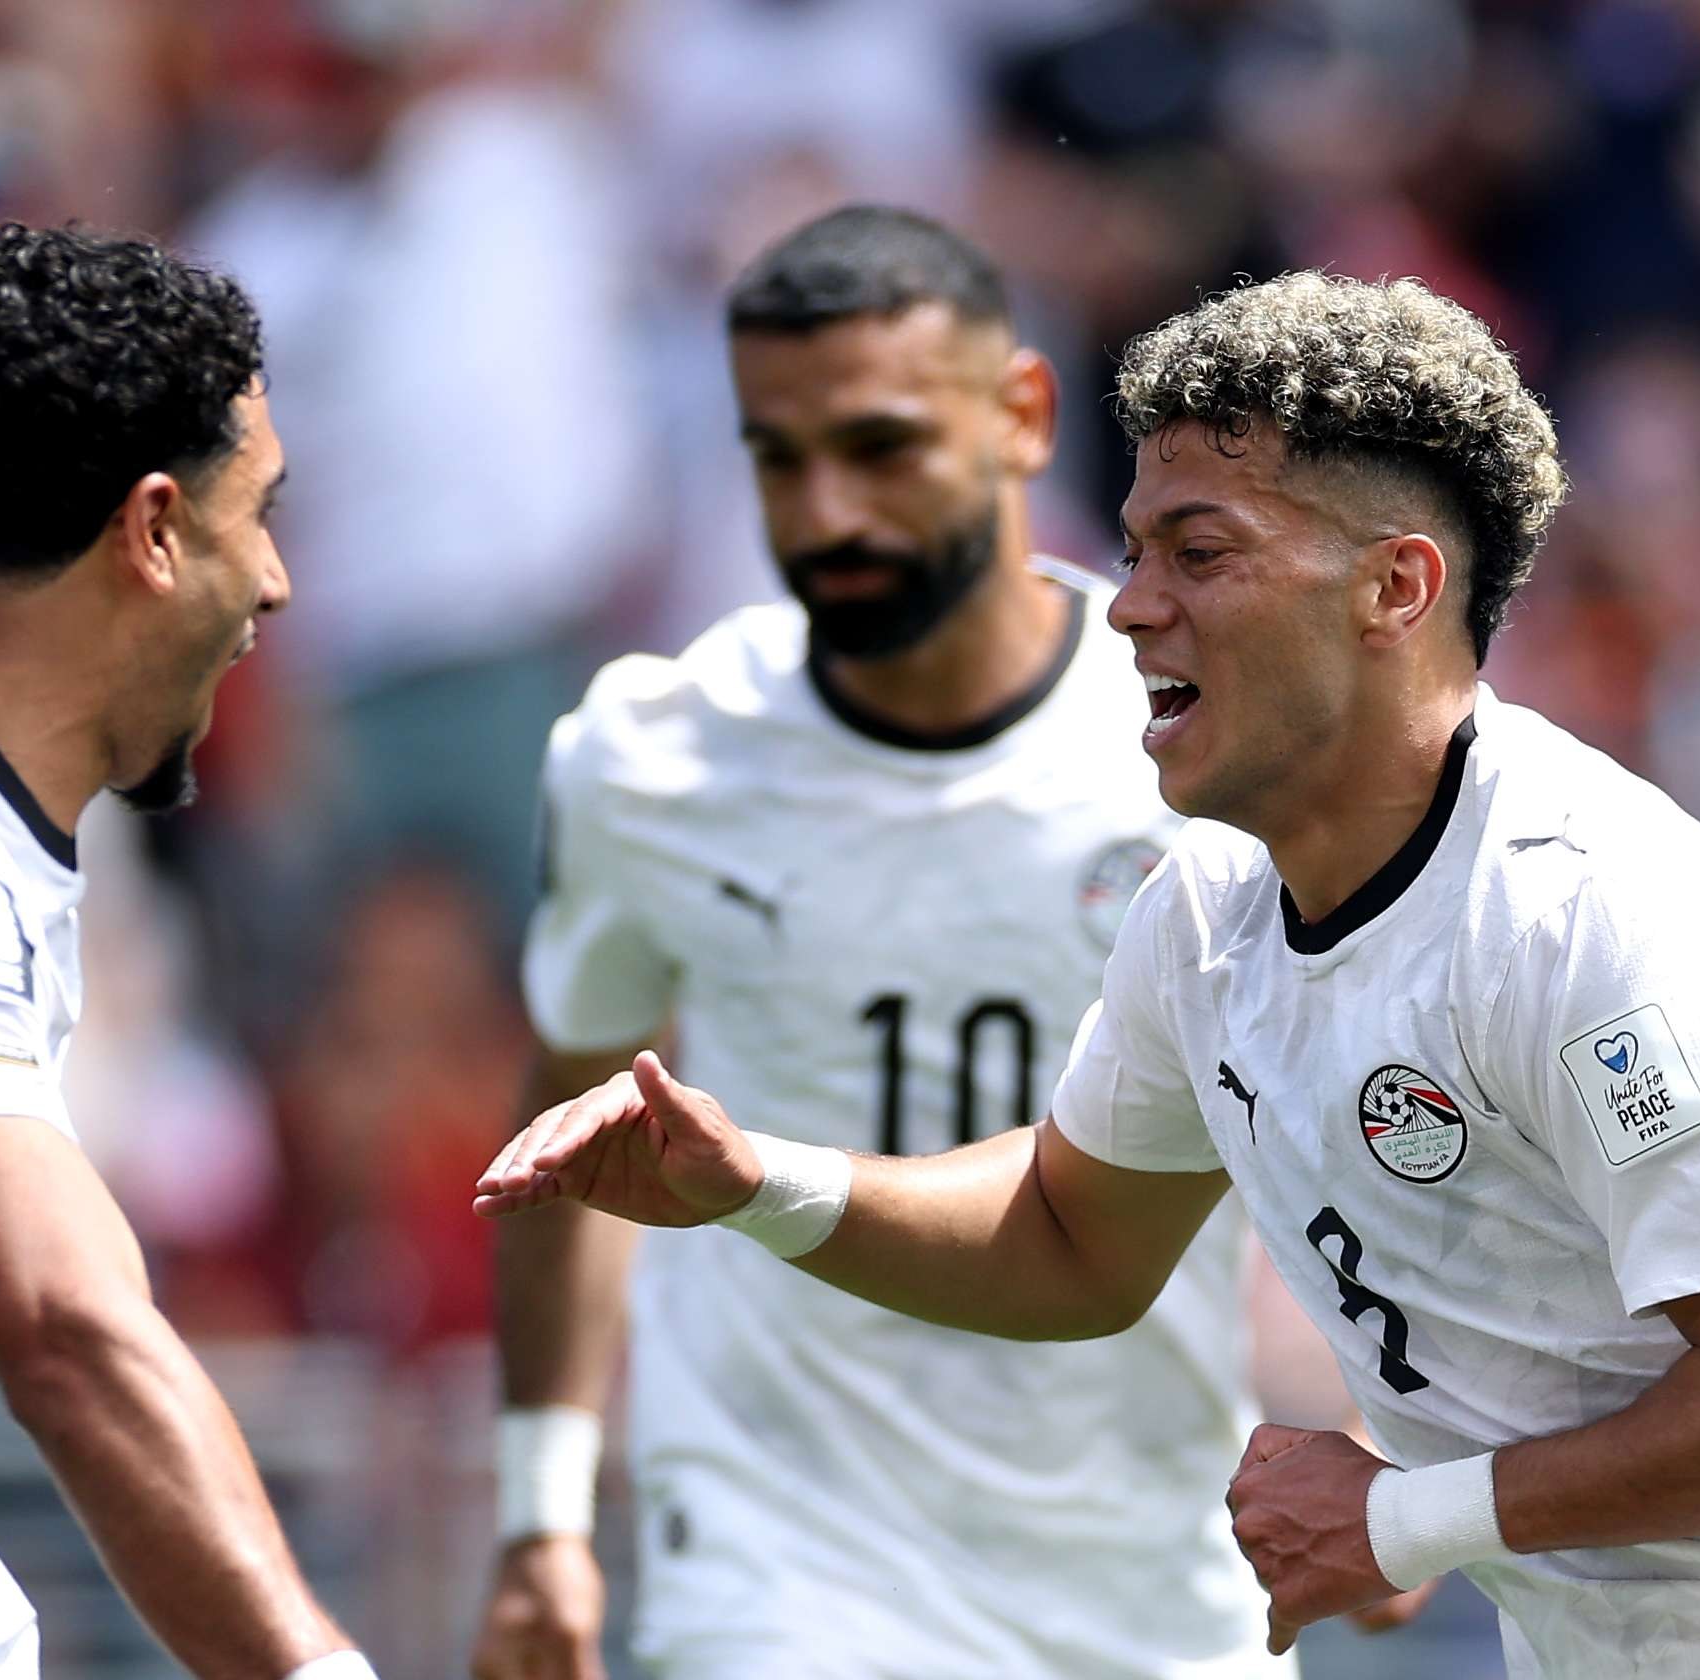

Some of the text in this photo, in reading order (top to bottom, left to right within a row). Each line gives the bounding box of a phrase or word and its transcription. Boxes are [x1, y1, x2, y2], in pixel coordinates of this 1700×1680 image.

[860, 994, 1036, 1157] 10
[1604, 1065, 1664, 1110] Unite For
[1617, 1088, 1675, 1132] PEACE
[1638, 1121, 1670, 1142] FIFA
[1401, 1153, 1450, 1172] EGYPTIAN FA
